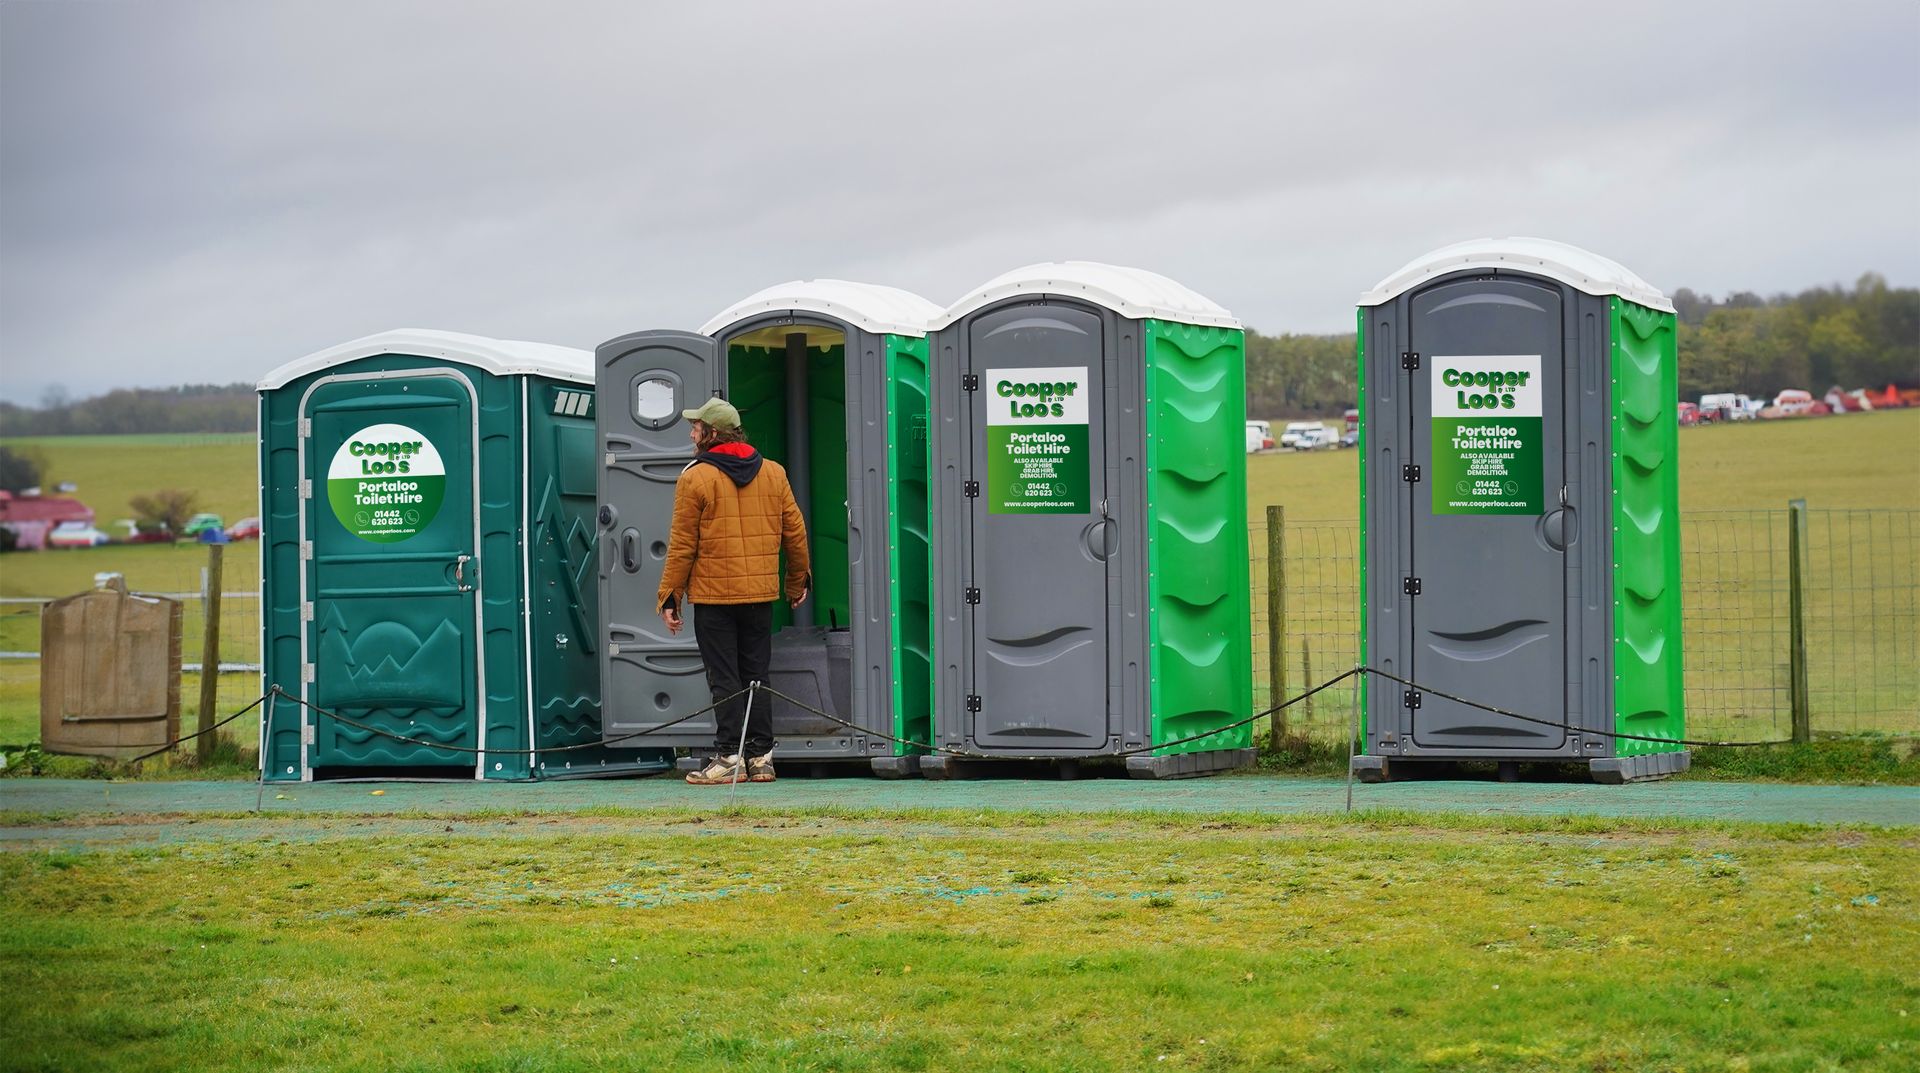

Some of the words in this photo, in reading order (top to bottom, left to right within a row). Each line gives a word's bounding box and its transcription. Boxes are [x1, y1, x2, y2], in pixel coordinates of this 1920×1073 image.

[1442, 368, 1531, 393] Cooper
[996, 380, 1078, 402] Cooper
[1457, 425, 1517, 437] Portaloo
[1010, 432, 1066, 443] Portaloo
[1451, 437, 1492, 449] Toilet
[1493, 436, 1522, 449] Hire
[349, 441, 423, 460] Cooper
[1005, 443, 1042, 454] Toilet
[1043, 442, 1071, 454] Hire
[358, 481, 418, 493] Portaloo
[354, 493, 393, 505] Toilet
[394, 492, 423, 504] Hire
[1449, 500, 1527, 508] www.cooperloos.com
[374, 510, 400, 518] 01442
[371, 518, 387, 526] 620
[388, 517, 403, 525] 623
